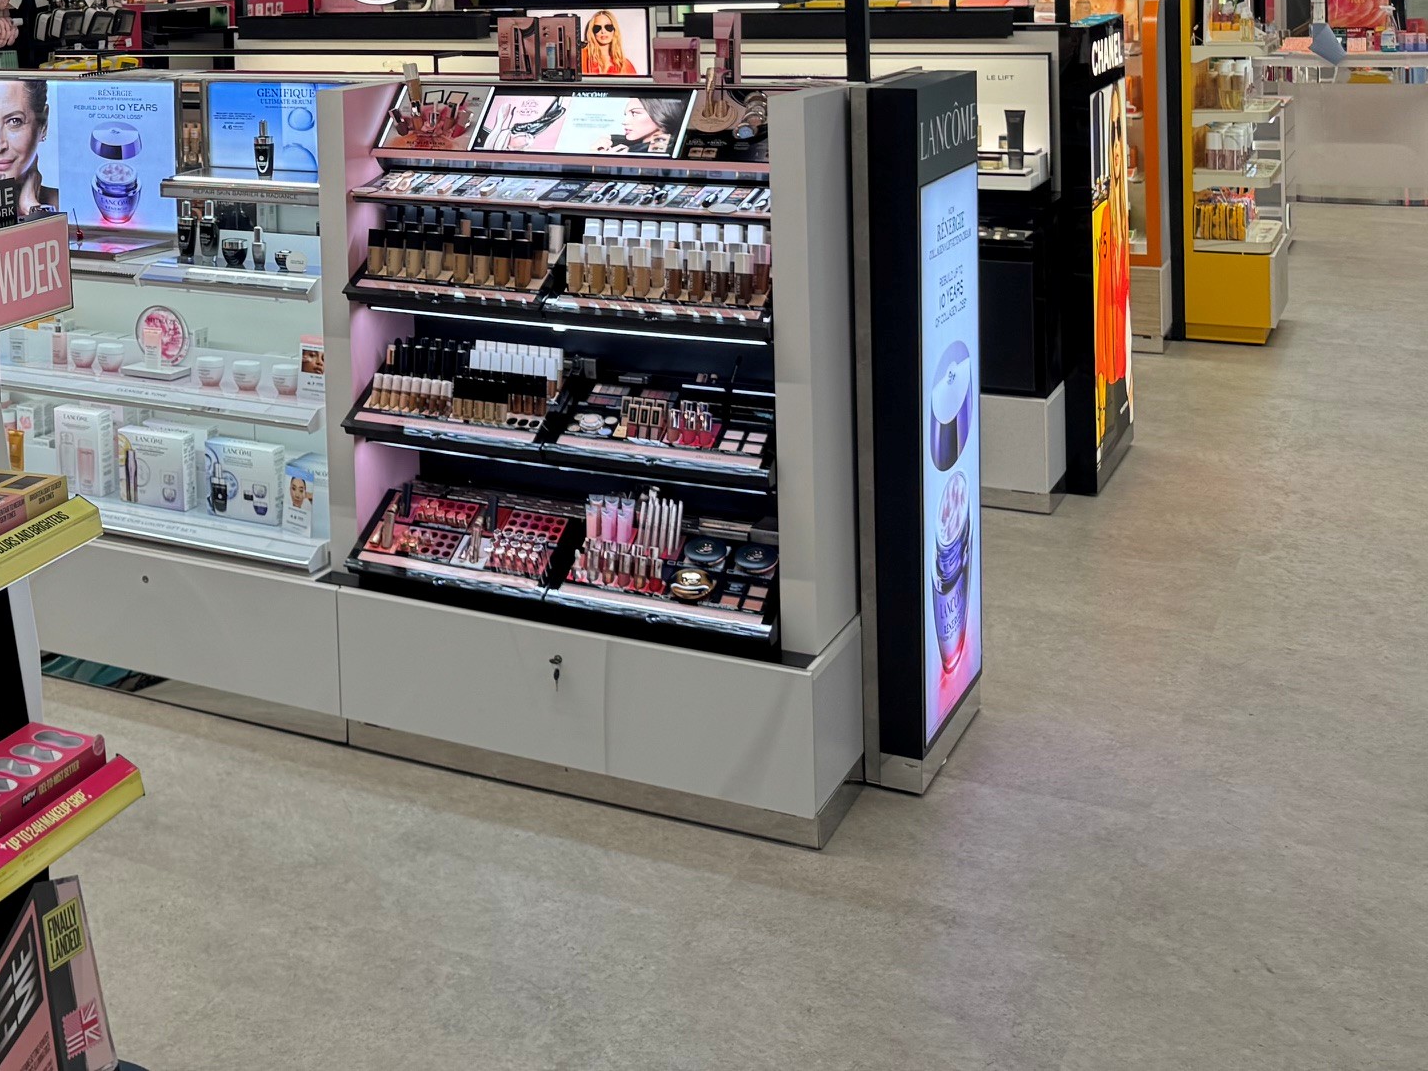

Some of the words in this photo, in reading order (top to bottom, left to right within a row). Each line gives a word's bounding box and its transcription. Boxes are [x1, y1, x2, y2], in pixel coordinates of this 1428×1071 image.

[1091, 31, 1123, 77] CHANEL
[920, 101, 976, 160] LANCÔME
[135, 435, 163, 445] LANCÔME
[222, 447, 252, 457] LANCÔME
[14, 528, 34, 545] AND
[27, 511, 70, 539] BRIGHTENS
[6, 837, 20, 851] UP
[28, 822, 45, 838] 24H
[42, 803, 72, 828] MAKEUP
[47, 903, 77, 941] FINALLY
[50, 926, 82, 963] LANDED!
